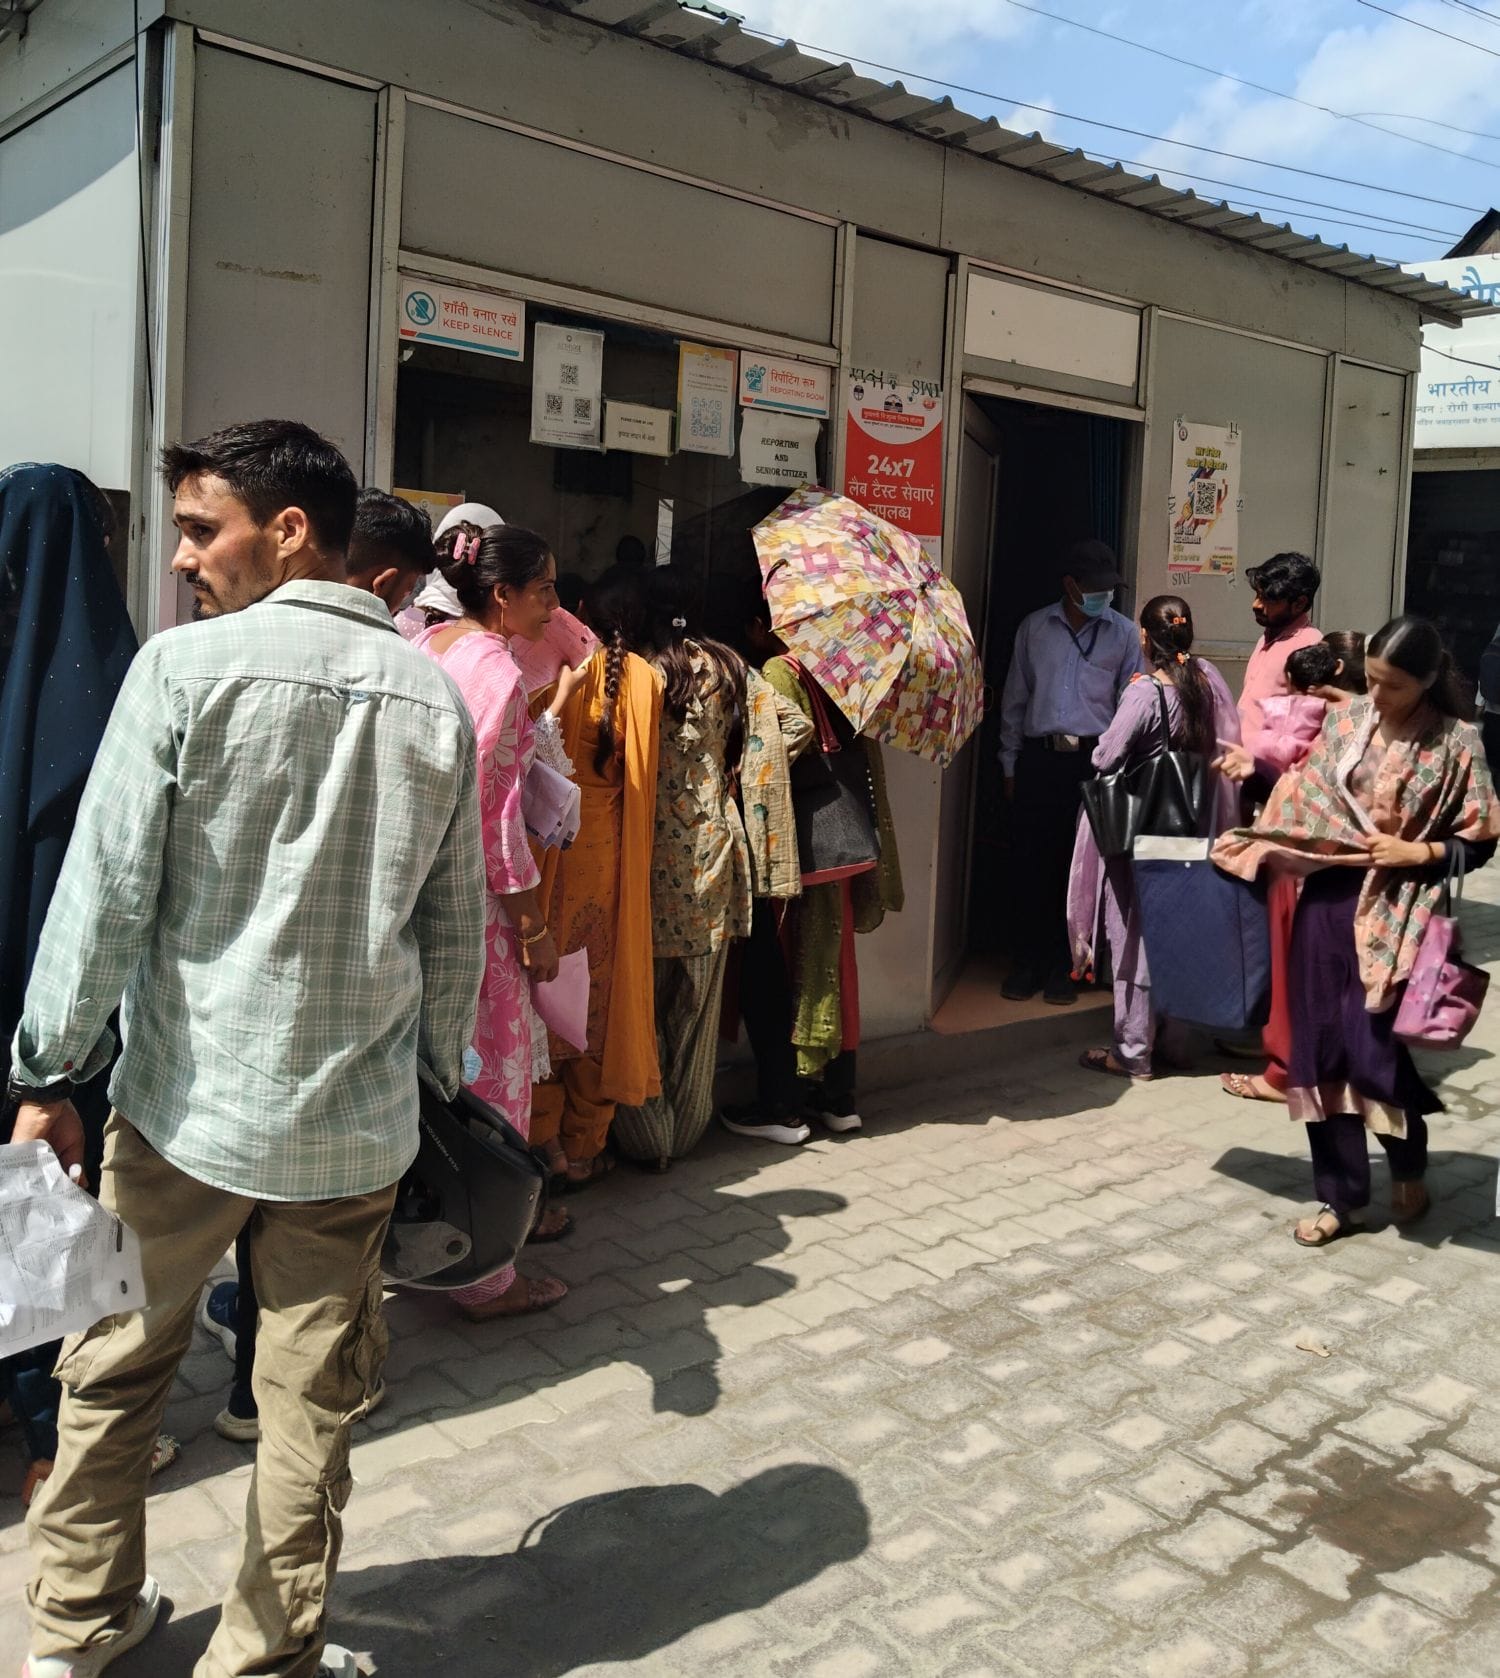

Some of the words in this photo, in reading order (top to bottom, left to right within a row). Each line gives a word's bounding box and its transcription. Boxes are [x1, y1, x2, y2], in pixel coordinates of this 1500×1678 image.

[443, 318, 470, 331] KEEP
[472, 324, 513, 340] SILENCE
[770, 385, 805, 398] REPORTING
[806, 391, 825, 401] ROOM
[1427, 375, 1492, 398] भारतीय
[1447, 401, 1468, 413] रोगी
[761, 437, 800, 450] REPORTING
[774, 454, 789, 463] AND
[867, 454, 915, 478] 24x7
[756, 466, 781, 476] SENIOR
[781, 469, 808, 479] CITIZEN
[848, 475, 868, 497] लैब
